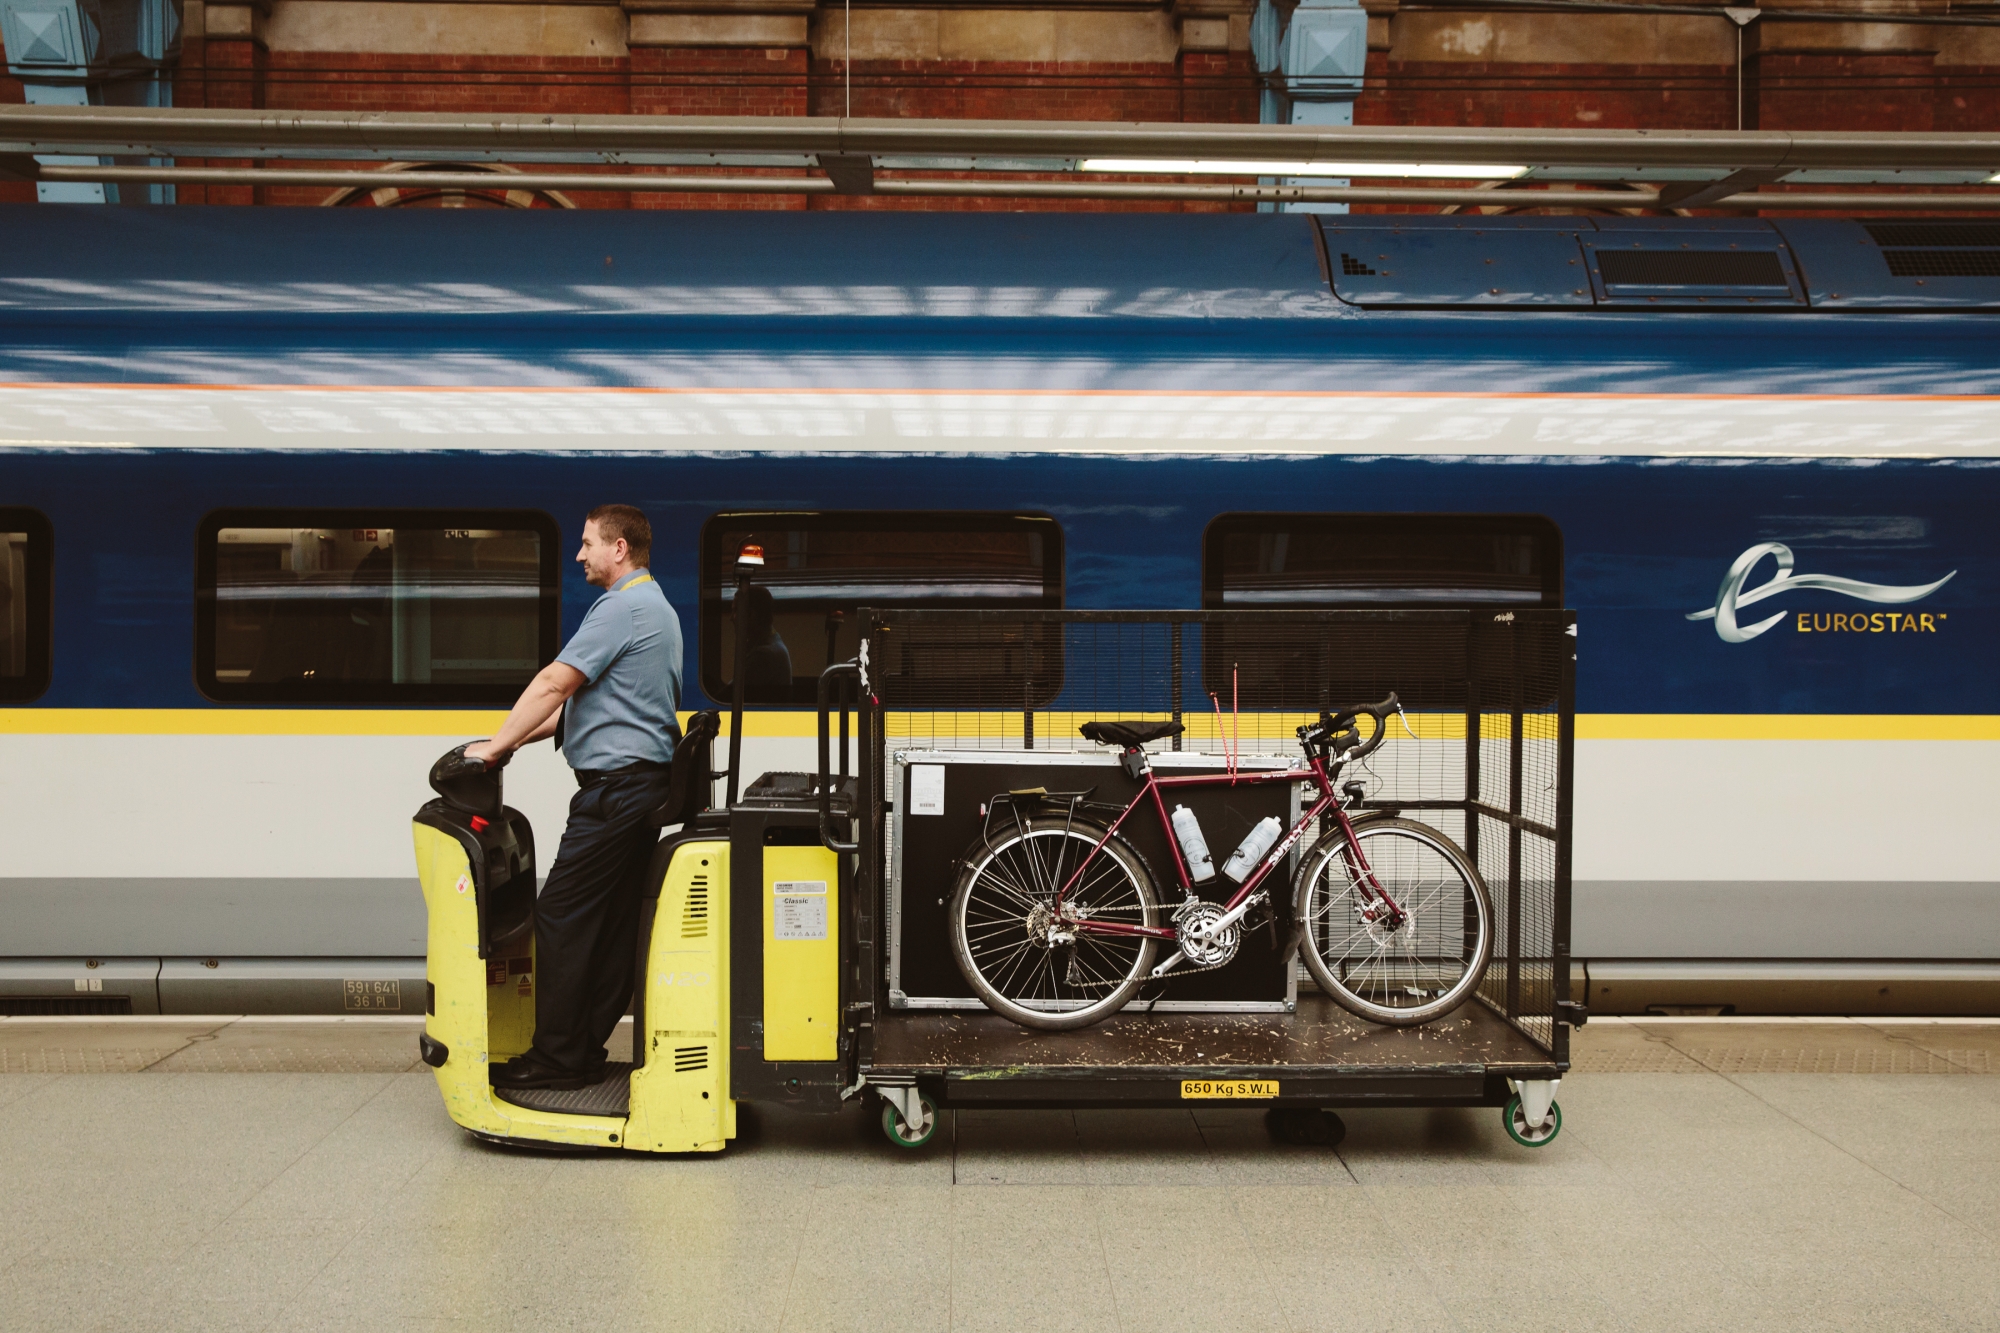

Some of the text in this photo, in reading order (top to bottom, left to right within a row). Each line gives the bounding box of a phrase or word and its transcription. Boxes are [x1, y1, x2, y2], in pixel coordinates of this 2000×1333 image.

[1268, 824, 1303, 867] SURLY
[354, 995, 370, 1006] 36
[1185, 1083, 1277, 1097] 650 Kg S.W.L.
